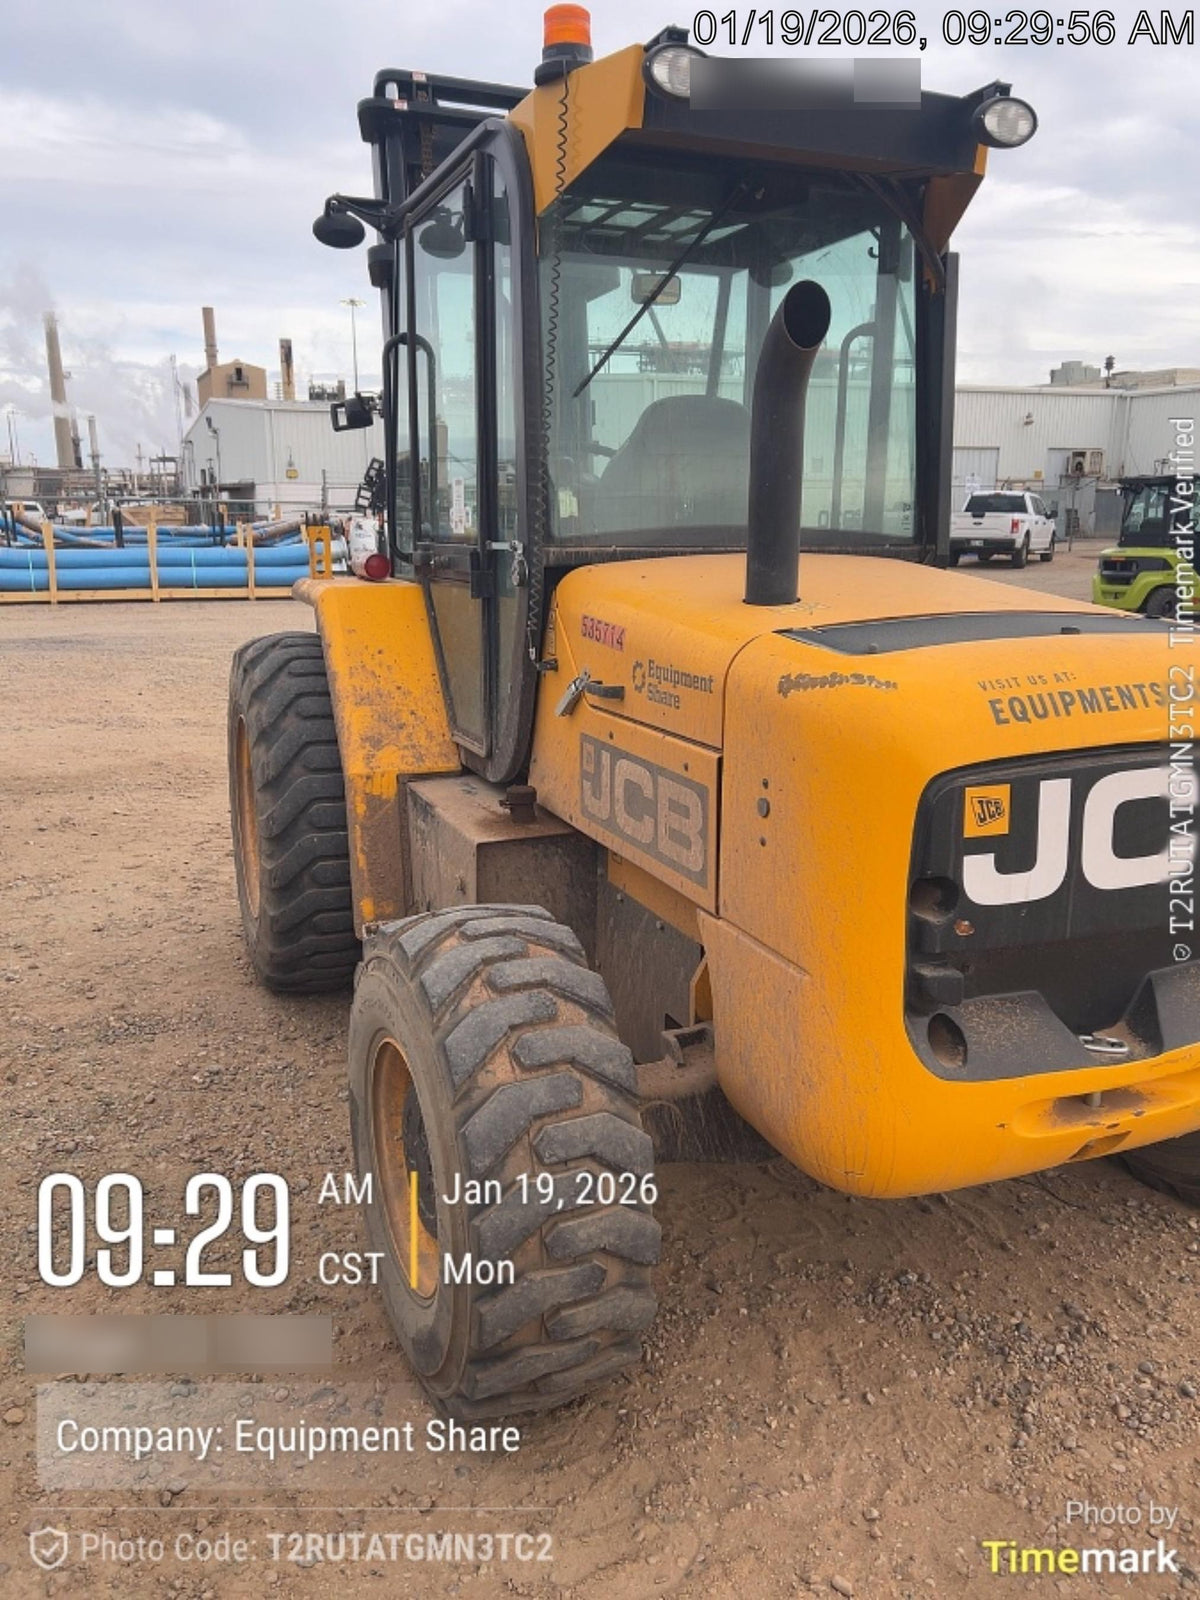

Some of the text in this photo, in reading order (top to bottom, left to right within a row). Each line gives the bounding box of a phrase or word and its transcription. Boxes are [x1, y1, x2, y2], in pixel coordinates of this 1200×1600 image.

[581, 614, 625, 651] 535714
[648, 659, 714, 694] Equipment
[978, 671, 1077, 692] VISIT US AT:
[647, 682, 681, 710] Share
[582, 749, 705, 872] JCB
[976, 799, 1003, 824] JCB
